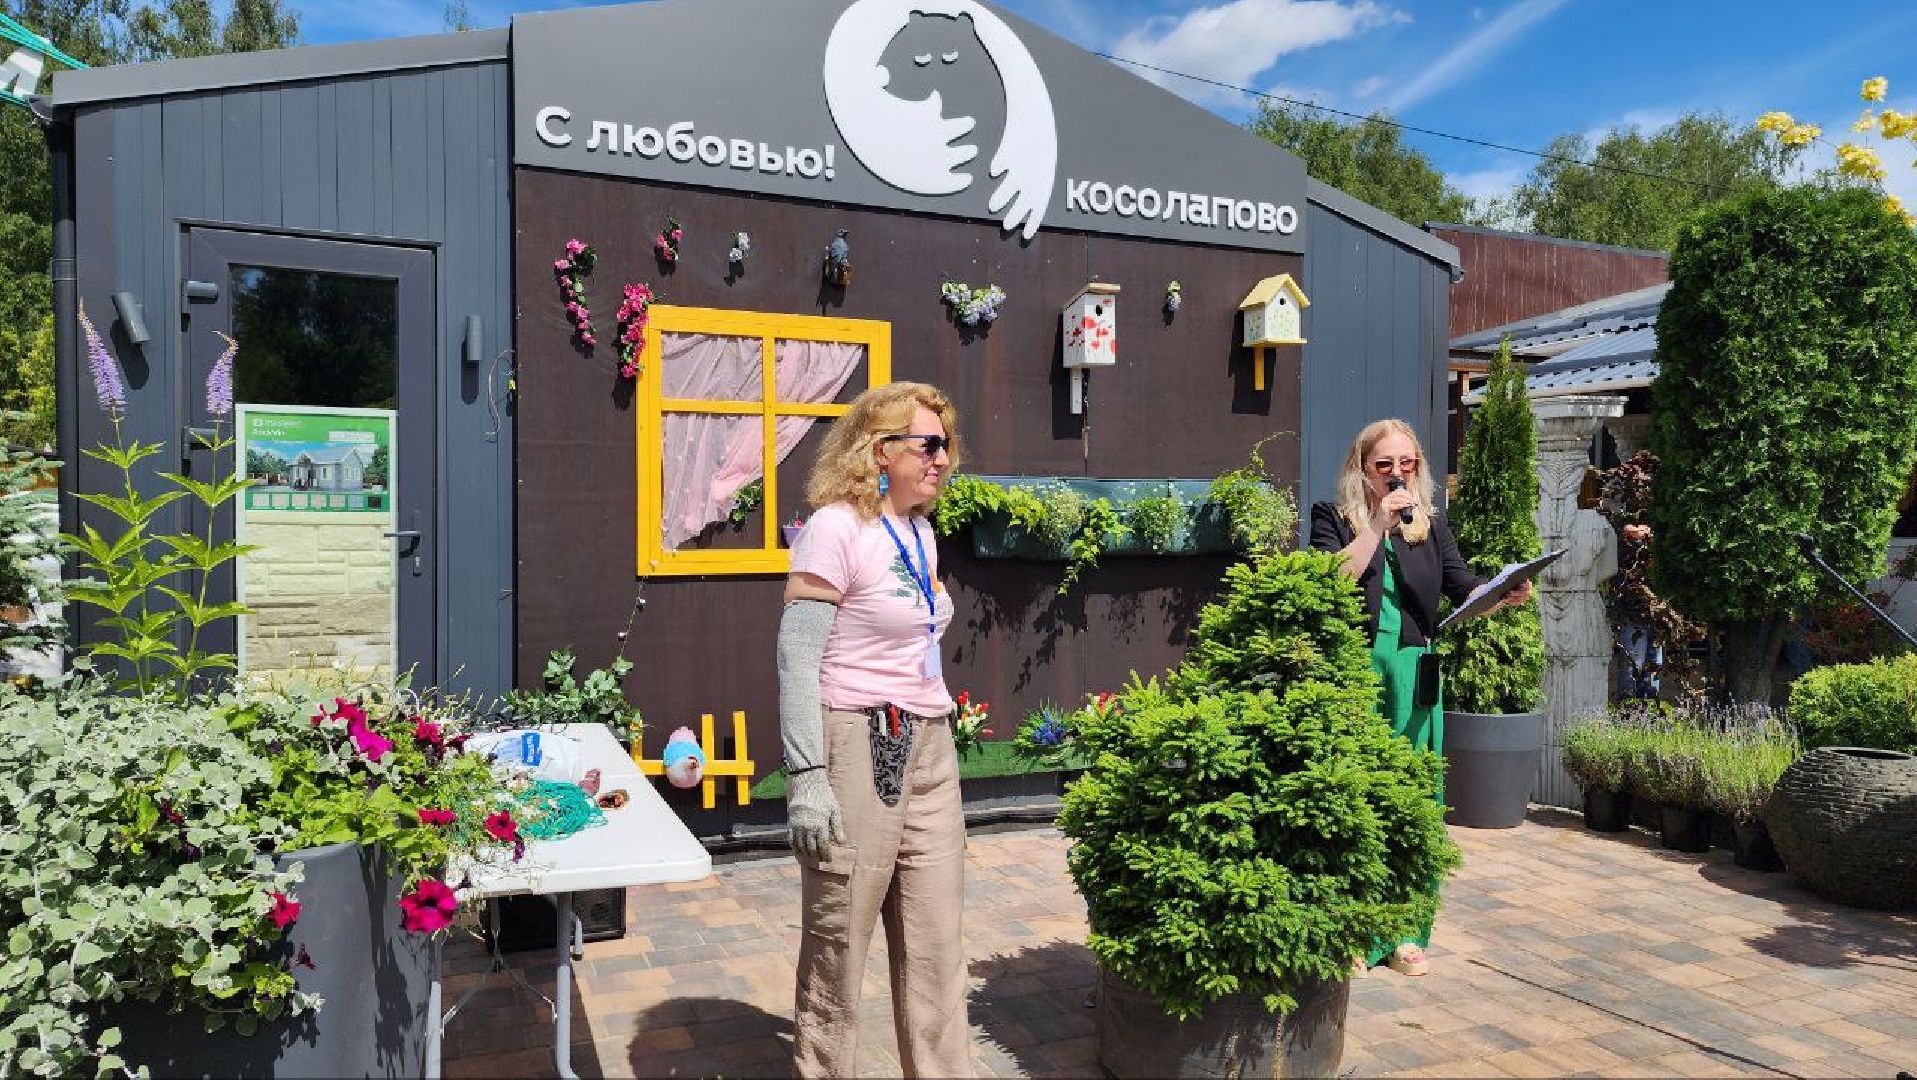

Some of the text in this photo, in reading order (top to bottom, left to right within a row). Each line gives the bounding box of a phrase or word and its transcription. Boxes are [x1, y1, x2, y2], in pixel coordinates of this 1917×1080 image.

[535, 105, 835, 181] С любовью!
[1065, 178, 1298, 236] косолапово
